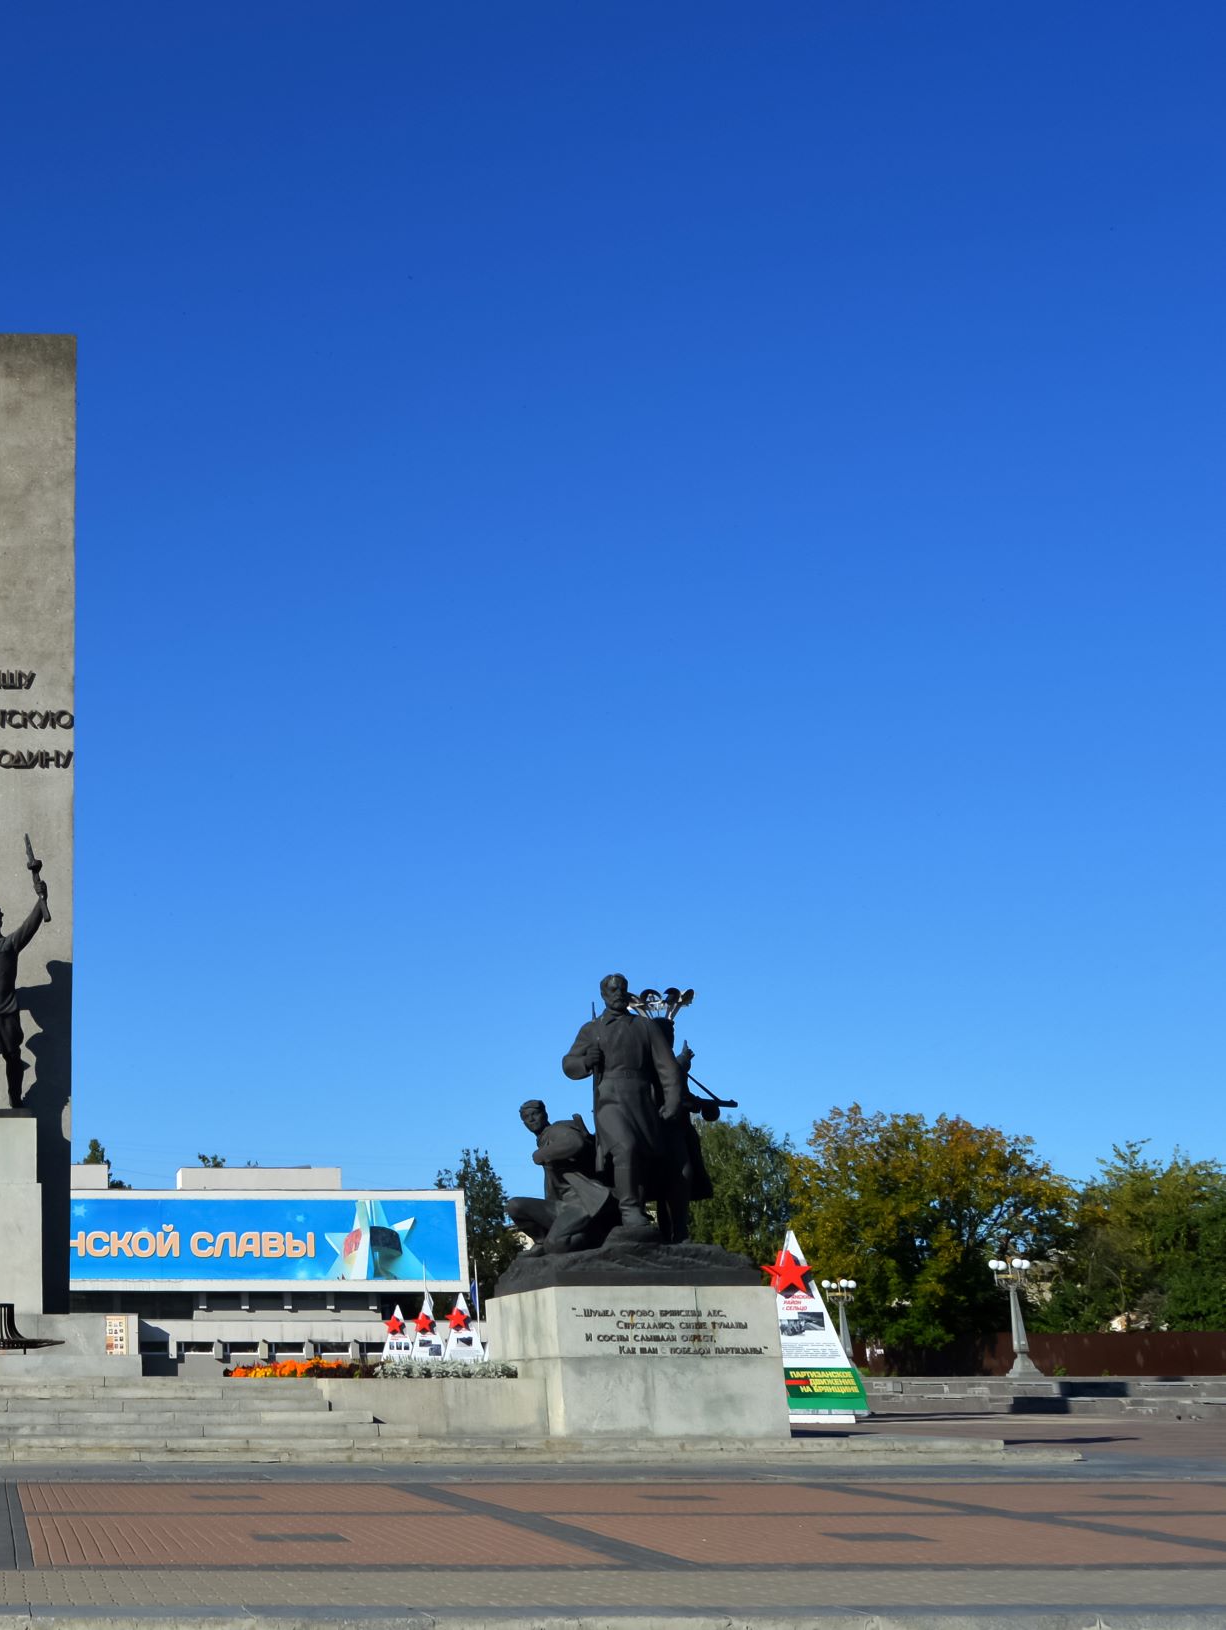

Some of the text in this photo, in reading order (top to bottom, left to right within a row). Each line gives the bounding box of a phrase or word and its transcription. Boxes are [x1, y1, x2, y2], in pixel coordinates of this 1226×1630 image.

[190, 1231, 315, 1258] СЛАВЫ
[620, 1309, 655, 1317] СУРОВО
[659, 1309, 703, 1318] БРЯНСКИЙ
[707, 1309, 727, 1318] ЛЕС,
[616, 1320, 748, 1329] СПУСКАЛИСЬ СИНИЕ ТУМАНЫ
[585, 1333, 593, 1341] И
[597, 1334, 629, 1342] СОСНЫ
[634, 1334, 677, 1342] СЛЫШАЛИ
[619, 1345, 636, 1354] КАК
[812, 1386, 860, 1394] БРЯНЩИНЕ
